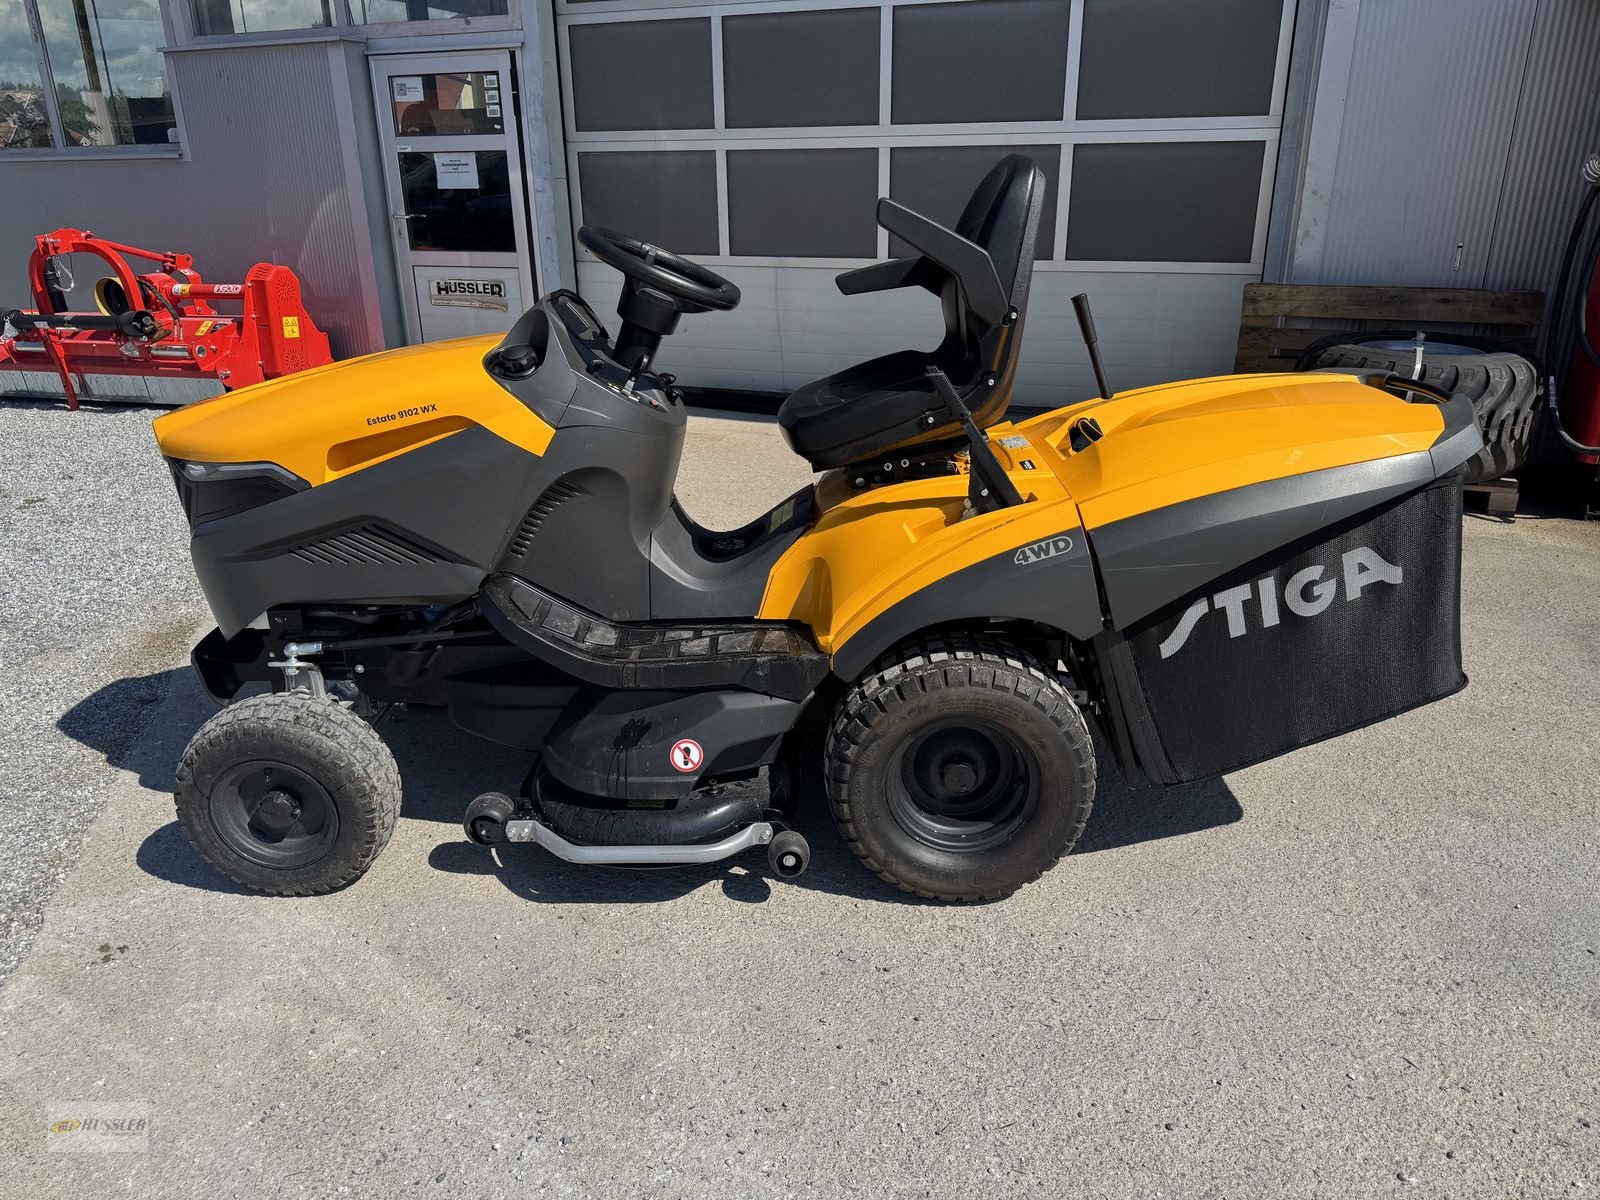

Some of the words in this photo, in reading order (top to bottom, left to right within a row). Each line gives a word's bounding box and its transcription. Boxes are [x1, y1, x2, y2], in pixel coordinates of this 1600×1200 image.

[366, 413, 397, 426] Estate
[397, 407, 419, 419] 9102
[420, 403, 438, 414] WX
[1014, 536, 1073, 565] 4WD
[1159, 546, 1403, 660] STIGA
